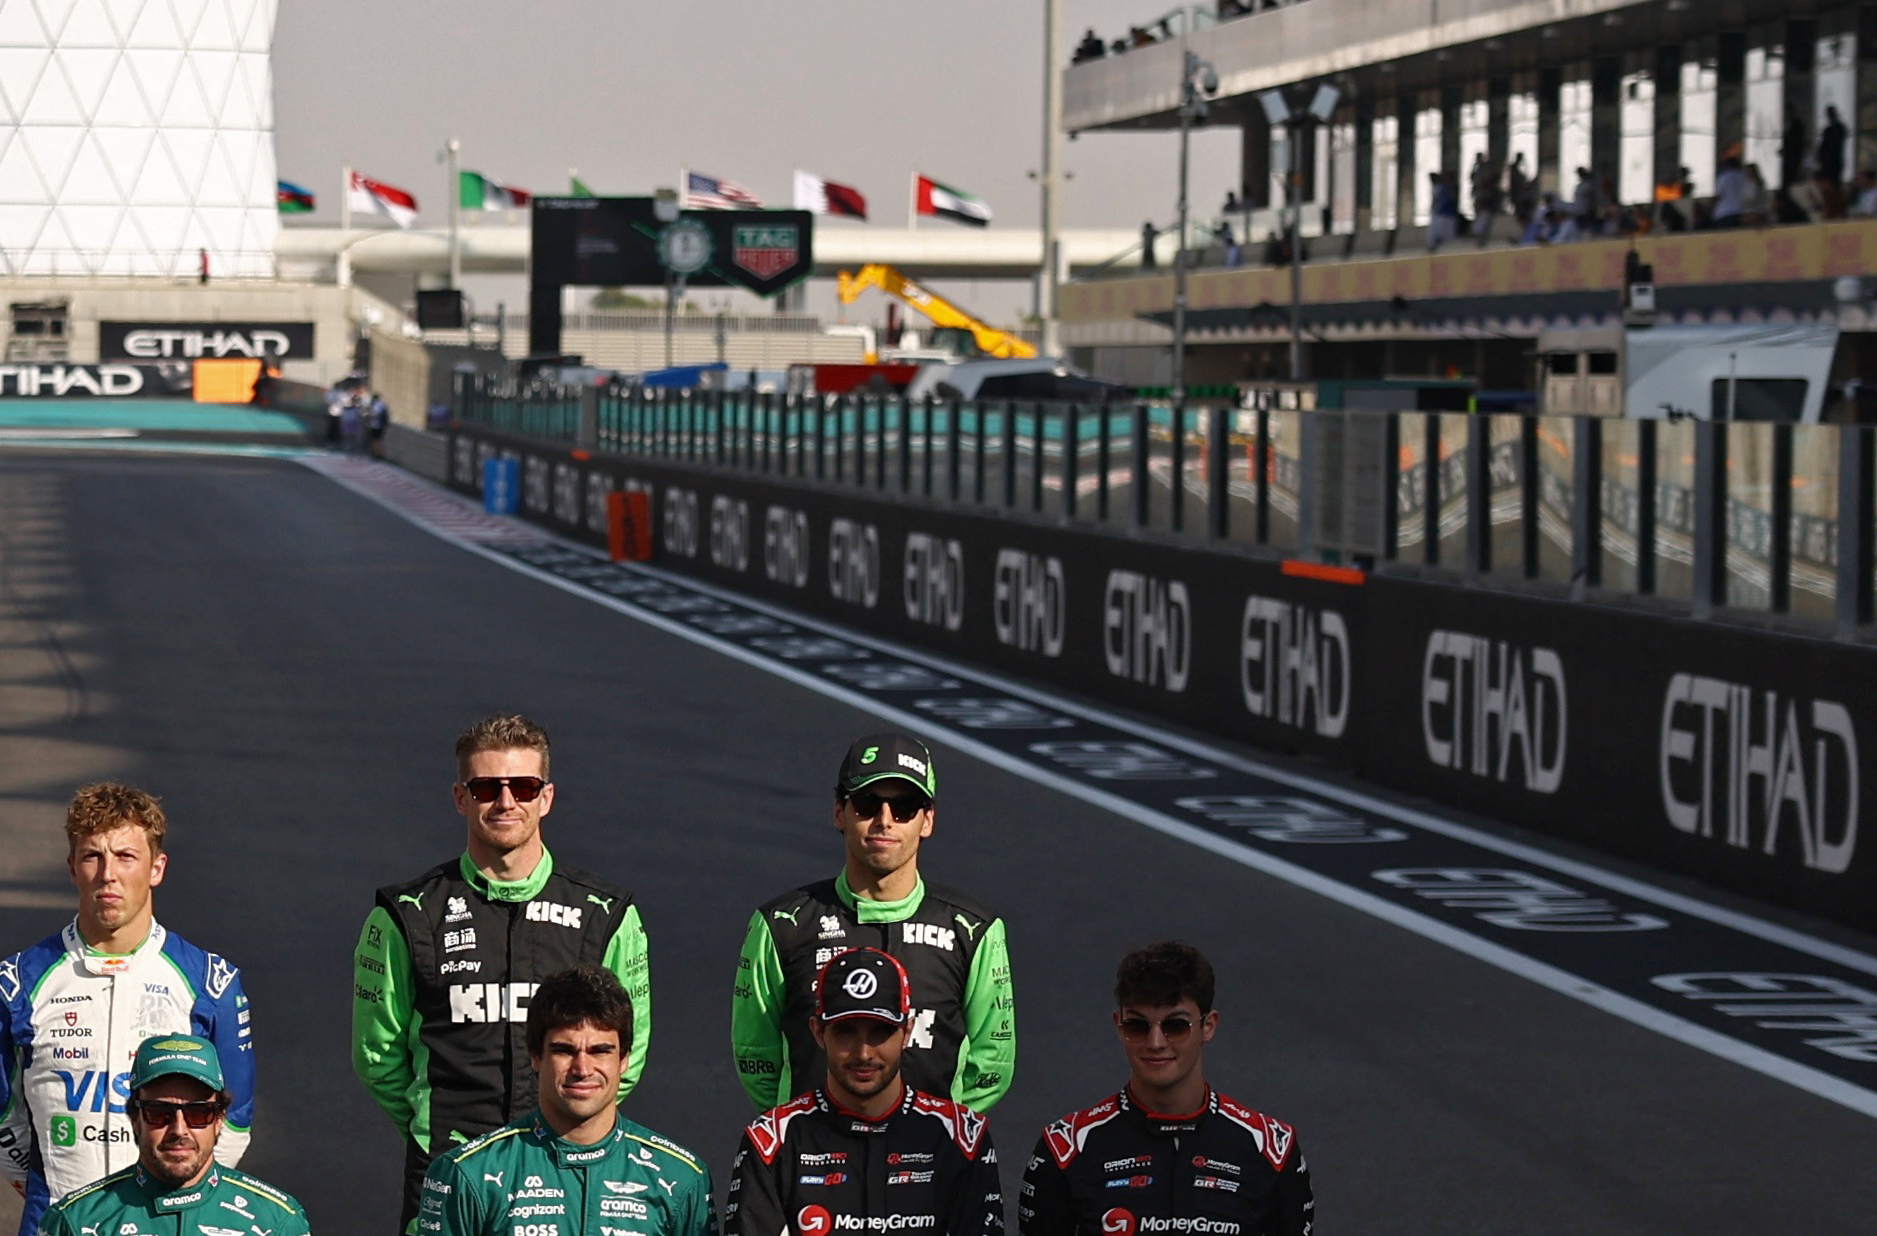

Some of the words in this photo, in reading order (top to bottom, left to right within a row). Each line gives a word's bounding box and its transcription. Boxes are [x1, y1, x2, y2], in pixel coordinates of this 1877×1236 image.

[739, 228, 795, 248] TAG
[124, 329, 290, 358] ETIHAD
[828, 518, 881, 608] ETIHAD
[903, 532, 964, 631] ETIHAD
[994, 548, 1066, 657] ETIHAD
[1104, 569, 1191, 692] ETIHAD
[1240, 596, 1351, 738] ETIHAD
[1422, 629, 1568, 794] ETIHAD
[897, 753, 928, 776] KICK
[1660, 672, 1860, 874] ETIHAD
[1371, 867, 1671, 933] ETIHAD
[525, 900, 581, 929] KICK
[903, 922, 955, 951] KICK
[440, 960, 482, 975] PicPay
[50, 994, 93, 1004] HONDA
[143, 982, 170, 996] VISA
[448, 982, 542, 1024] KIC
[50, 1027, 93, 1038] TUDOR
[53, 1047, 89, 1059] Mobil
[50, 1069, 135, 1113] VIS
[82, 1123, 130, 1143] Cash
[566, 1149, 605, 1161] aramco
[650, 1135, 696, 1161] coinbase
[162, 1191, 202, 1206] aramco
[242, 1175, 288, 1202] coinbase
[507, 1188, 564, 1201] MAADEN
[508, 1203, 565, 1218] cognizant
[600, 1200, 647, 1213] aramco
[834, 1213, 935, 1234] MoneyGram
[1139, 1216, 1241, 1236] MoneyGram
